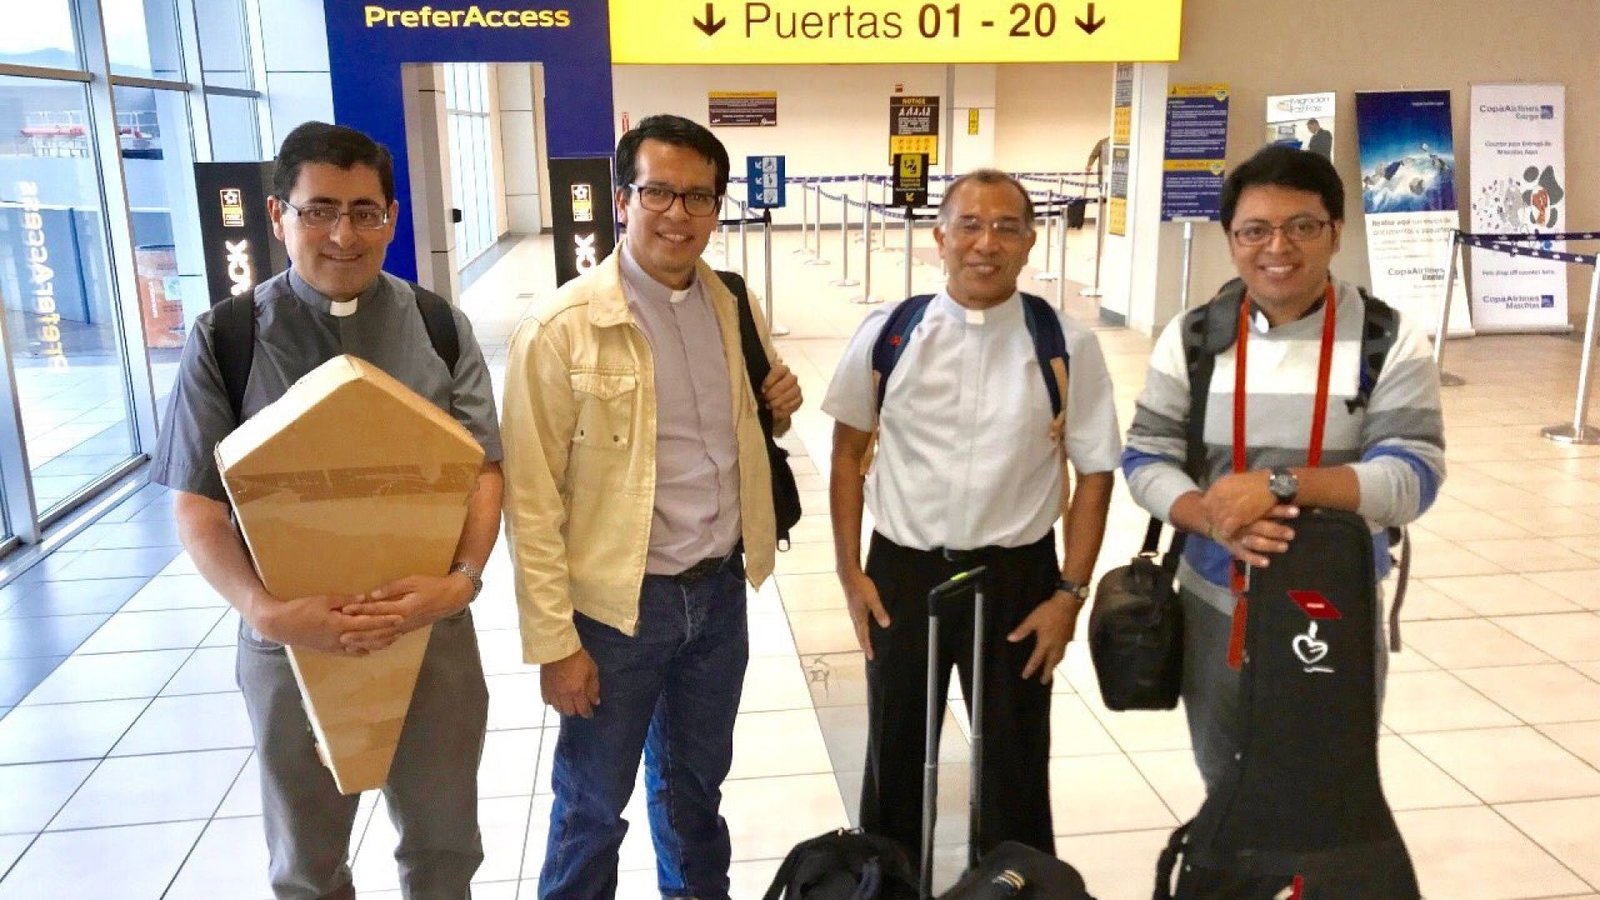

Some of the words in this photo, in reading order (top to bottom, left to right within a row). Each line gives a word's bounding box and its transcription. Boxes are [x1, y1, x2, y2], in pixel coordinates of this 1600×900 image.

[364, 5, 571, 28] PreferAccess
[745, 1, 903, 39] Puertas
[918, 2, 960, 38] 01
[1009, 2, 1056, 38] 20
